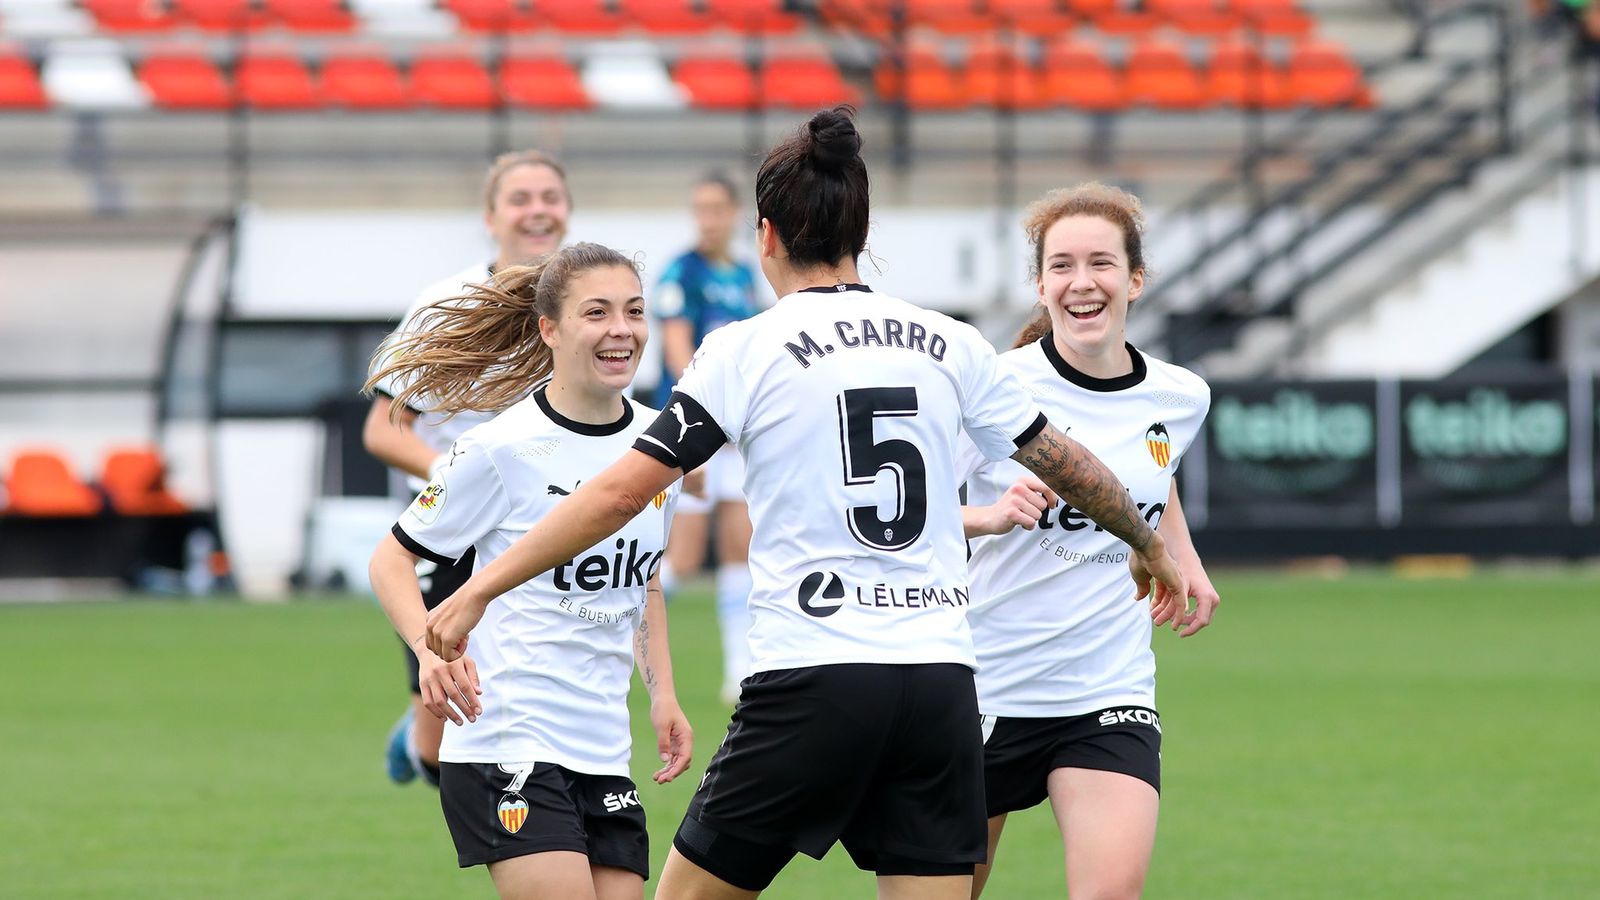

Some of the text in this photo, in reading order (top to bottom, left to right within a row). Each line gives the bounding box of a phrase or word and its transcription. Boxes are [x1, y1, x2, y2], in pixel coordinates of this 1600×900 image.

[784, 318, 947, 369] M. CARRO
[1214, 391, 1374, 459] teika
[1407, 388, 1568, 459] teika
[836, 386, 928, 552] 5
[1054, 545, 1092, 563] BUEN
[559, 596, 574, 613] EL
[578, 606, 612, 624] BUEN
